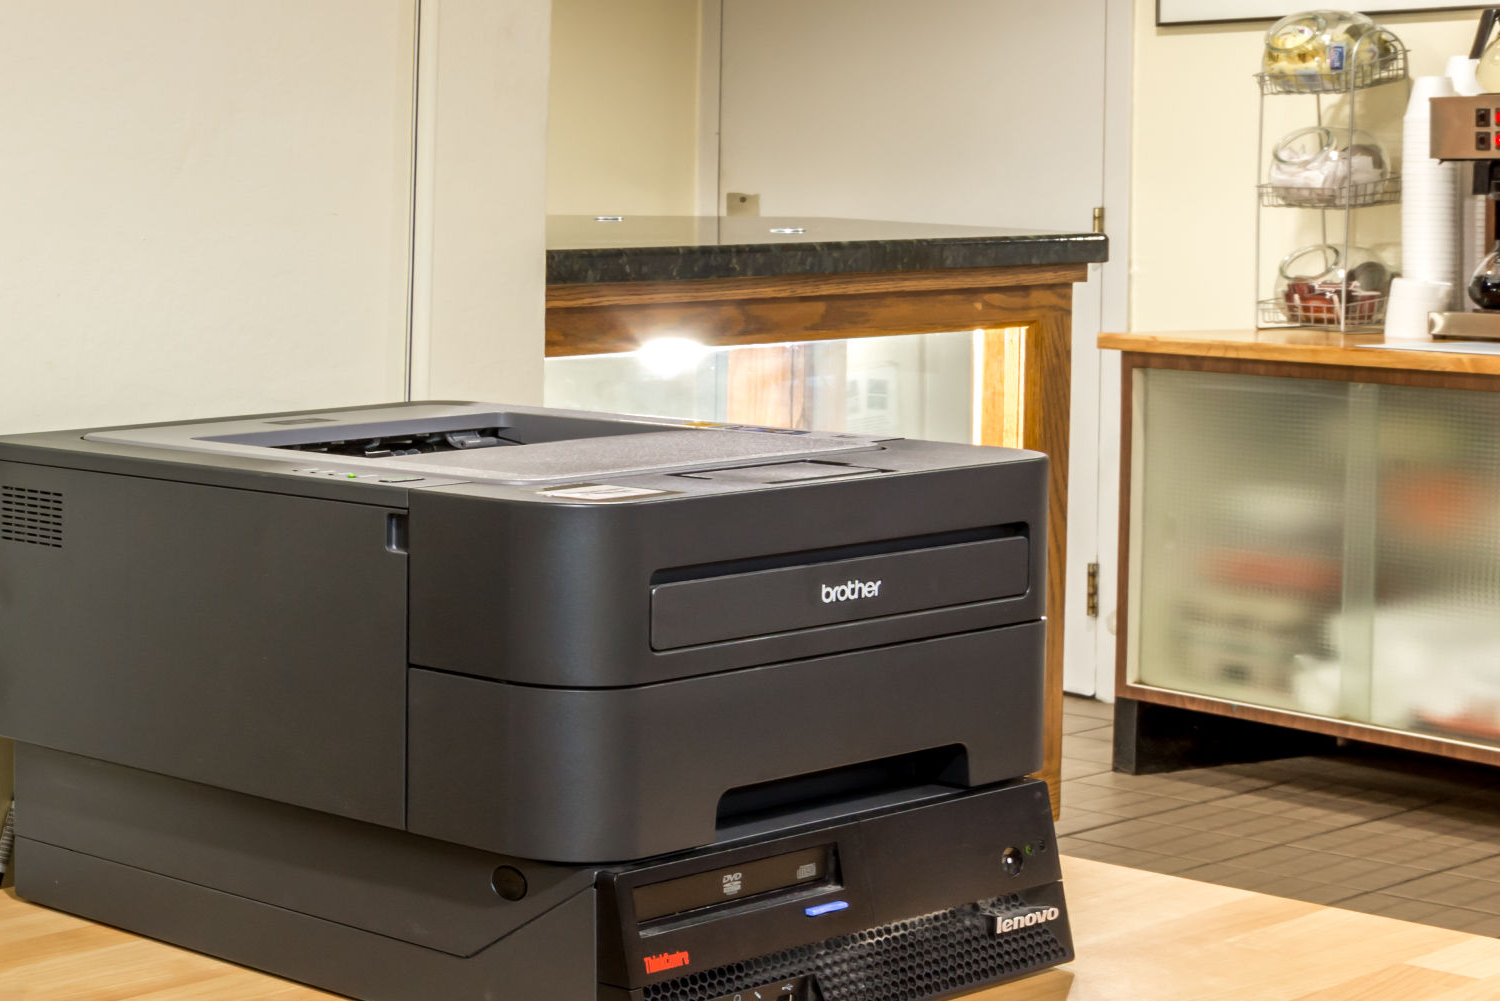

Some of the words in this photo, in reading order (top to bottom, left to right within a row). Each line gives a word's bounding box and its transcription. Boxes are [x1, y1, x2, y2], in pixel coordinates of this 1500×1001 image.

[821, 580, 882, 603] brother
[722, 872, 742, 883] DVD
[996, 907, 1059, 934] lenovo
